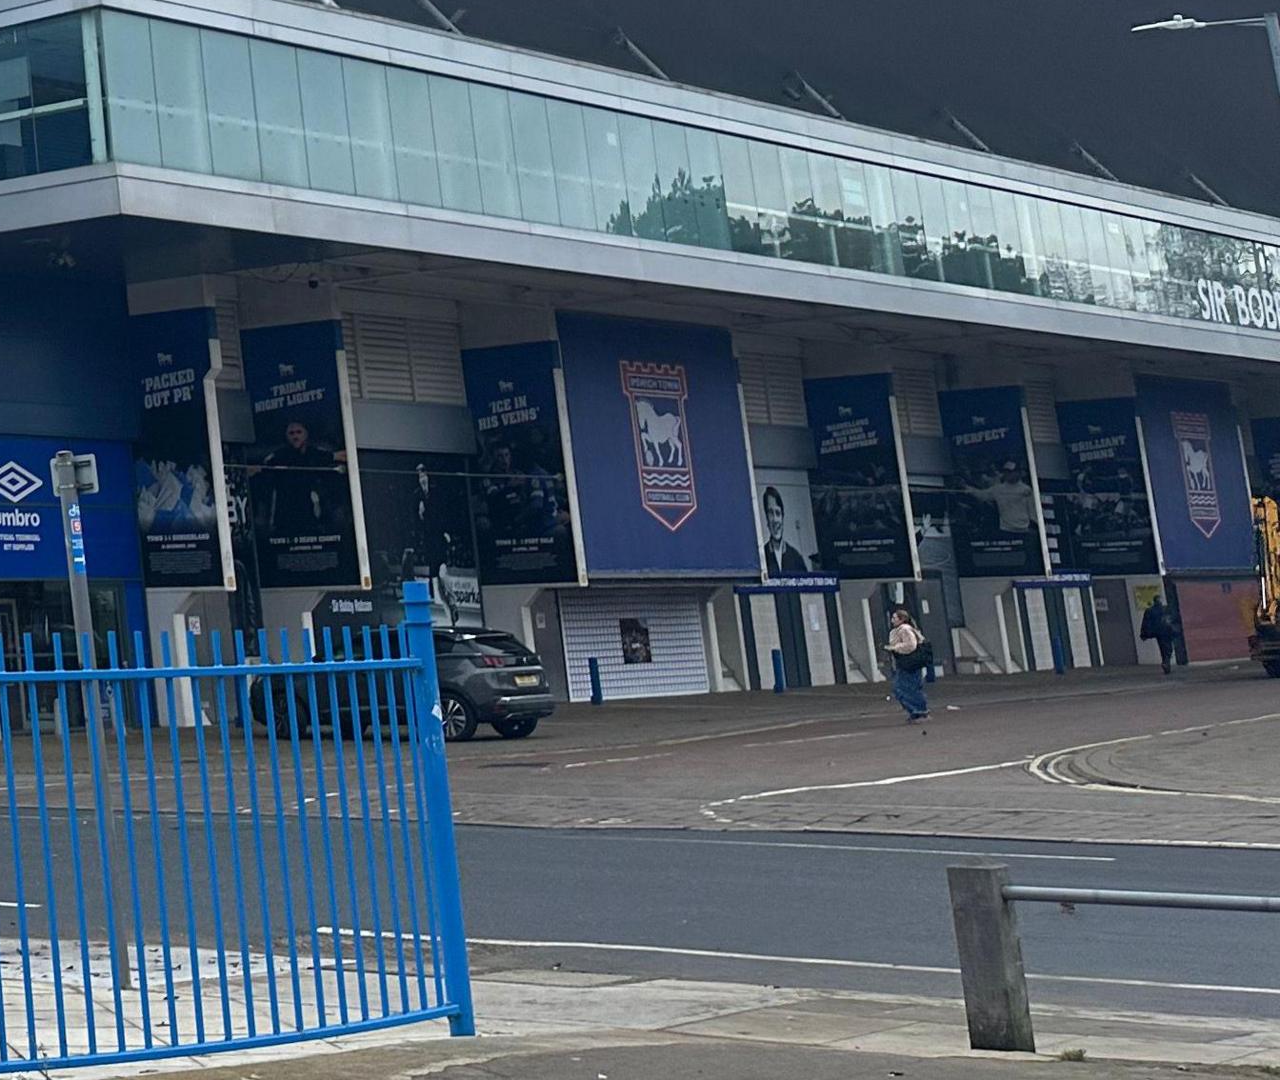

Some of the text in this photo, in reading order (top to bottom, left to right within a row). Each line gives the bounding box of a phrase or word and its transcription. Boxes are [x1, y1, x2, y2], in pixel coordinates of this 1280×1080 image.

[1197, 278, 1231, 323] SIR
[144, 390, 170, 409] OUT
[514, 394, 527, 410] IN
[478, 415, 499, 431] HIS
